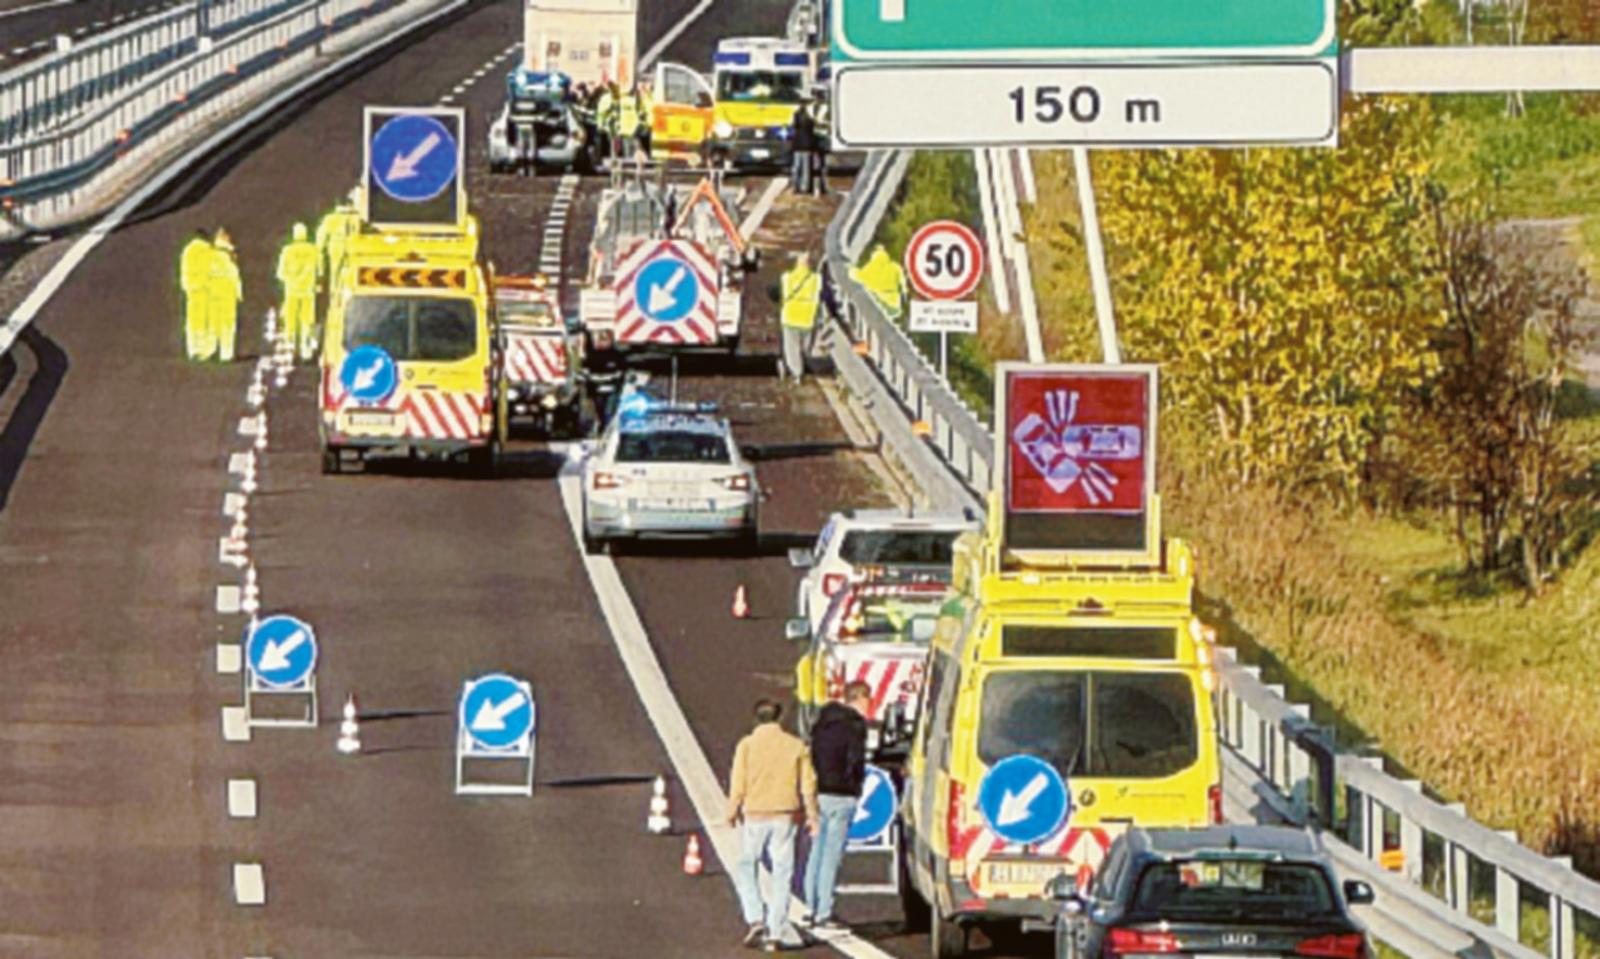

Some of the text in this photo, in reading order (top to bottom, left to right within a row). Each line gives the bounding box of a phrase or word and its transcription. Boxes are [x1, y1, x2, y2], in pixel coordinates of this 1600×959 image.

[1008, 86, 1161, 123] 150 m
[924, 243, 966, 277] 50
